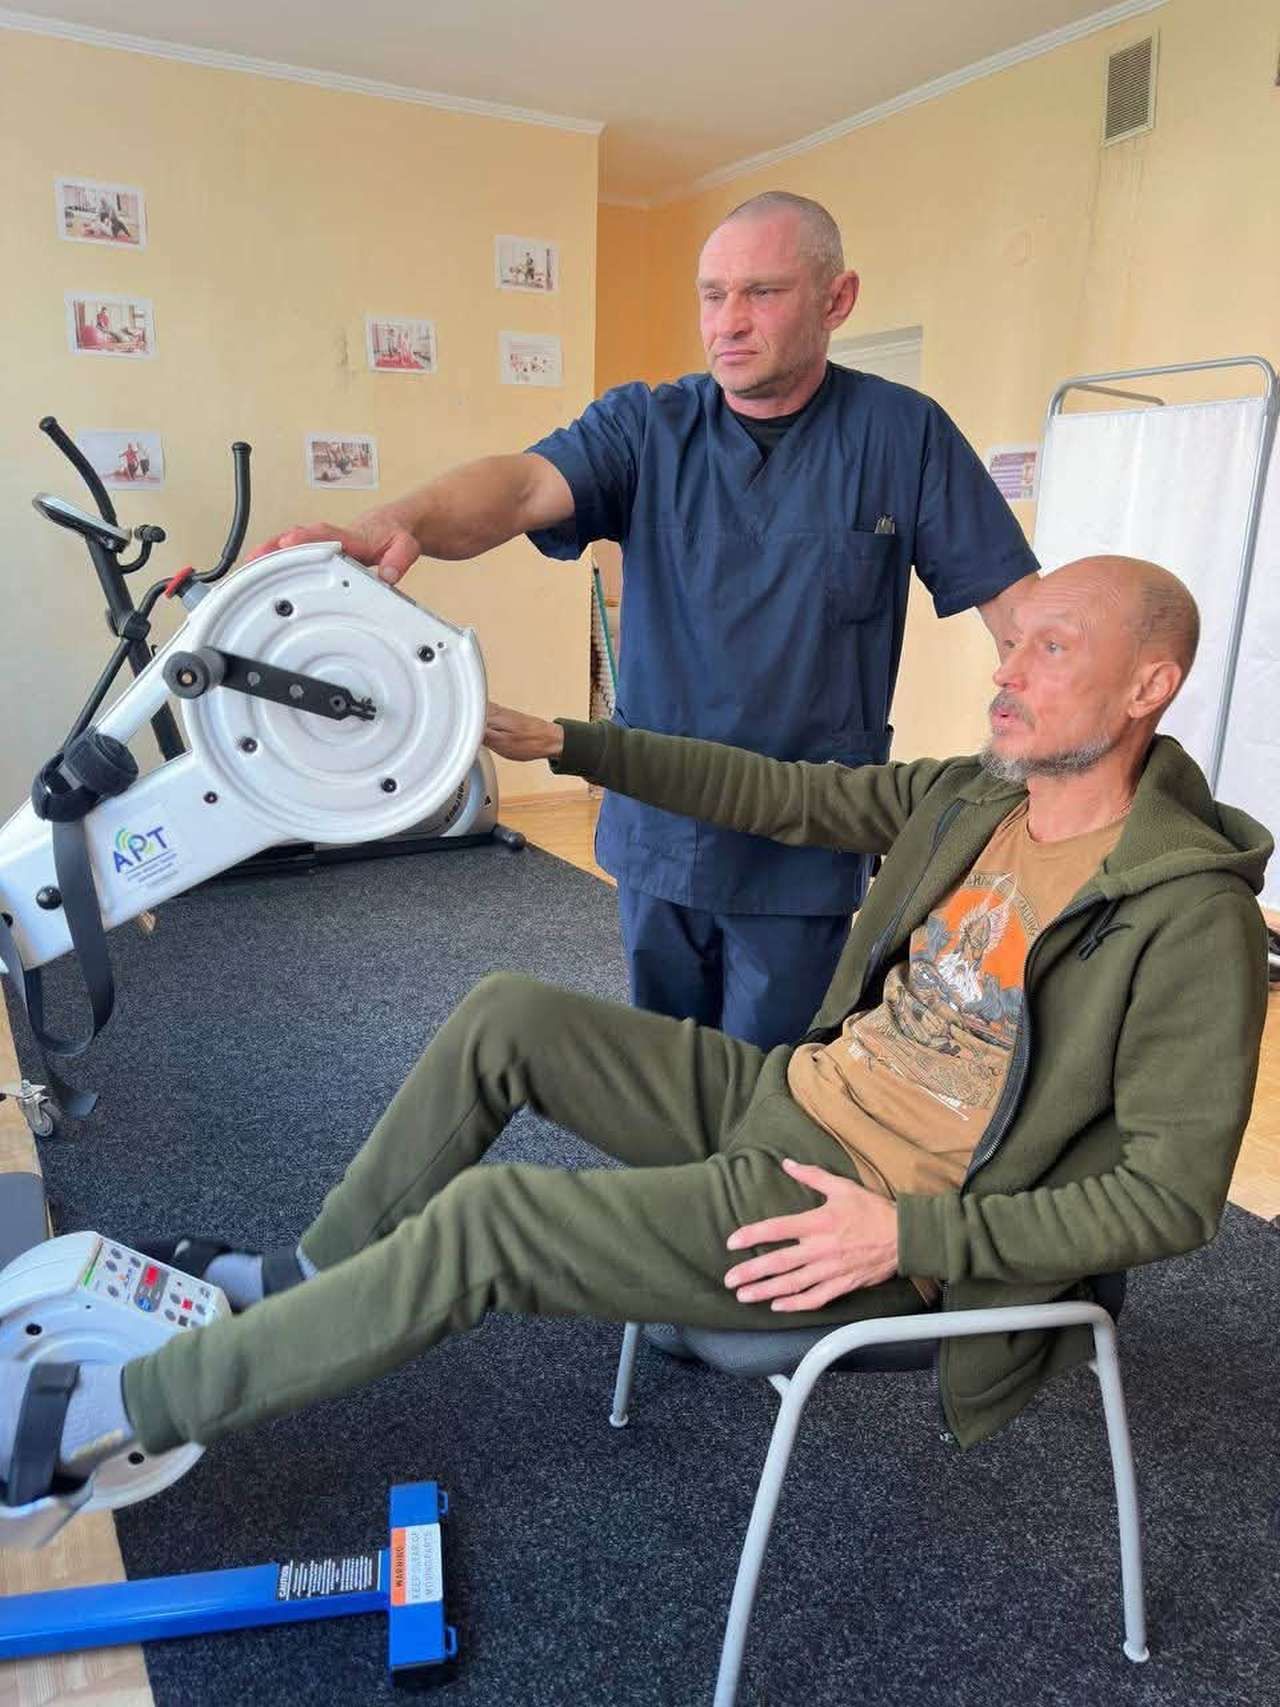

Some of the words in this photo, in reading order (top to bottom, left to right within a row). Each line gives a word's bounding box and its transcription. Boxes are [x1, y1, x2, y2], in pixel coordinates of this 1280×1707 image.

[113, 826, 167, 873] APT
[279, 1565, 289, 1597] CAUTION
[396, 1546, 405, 1587] WARNING
